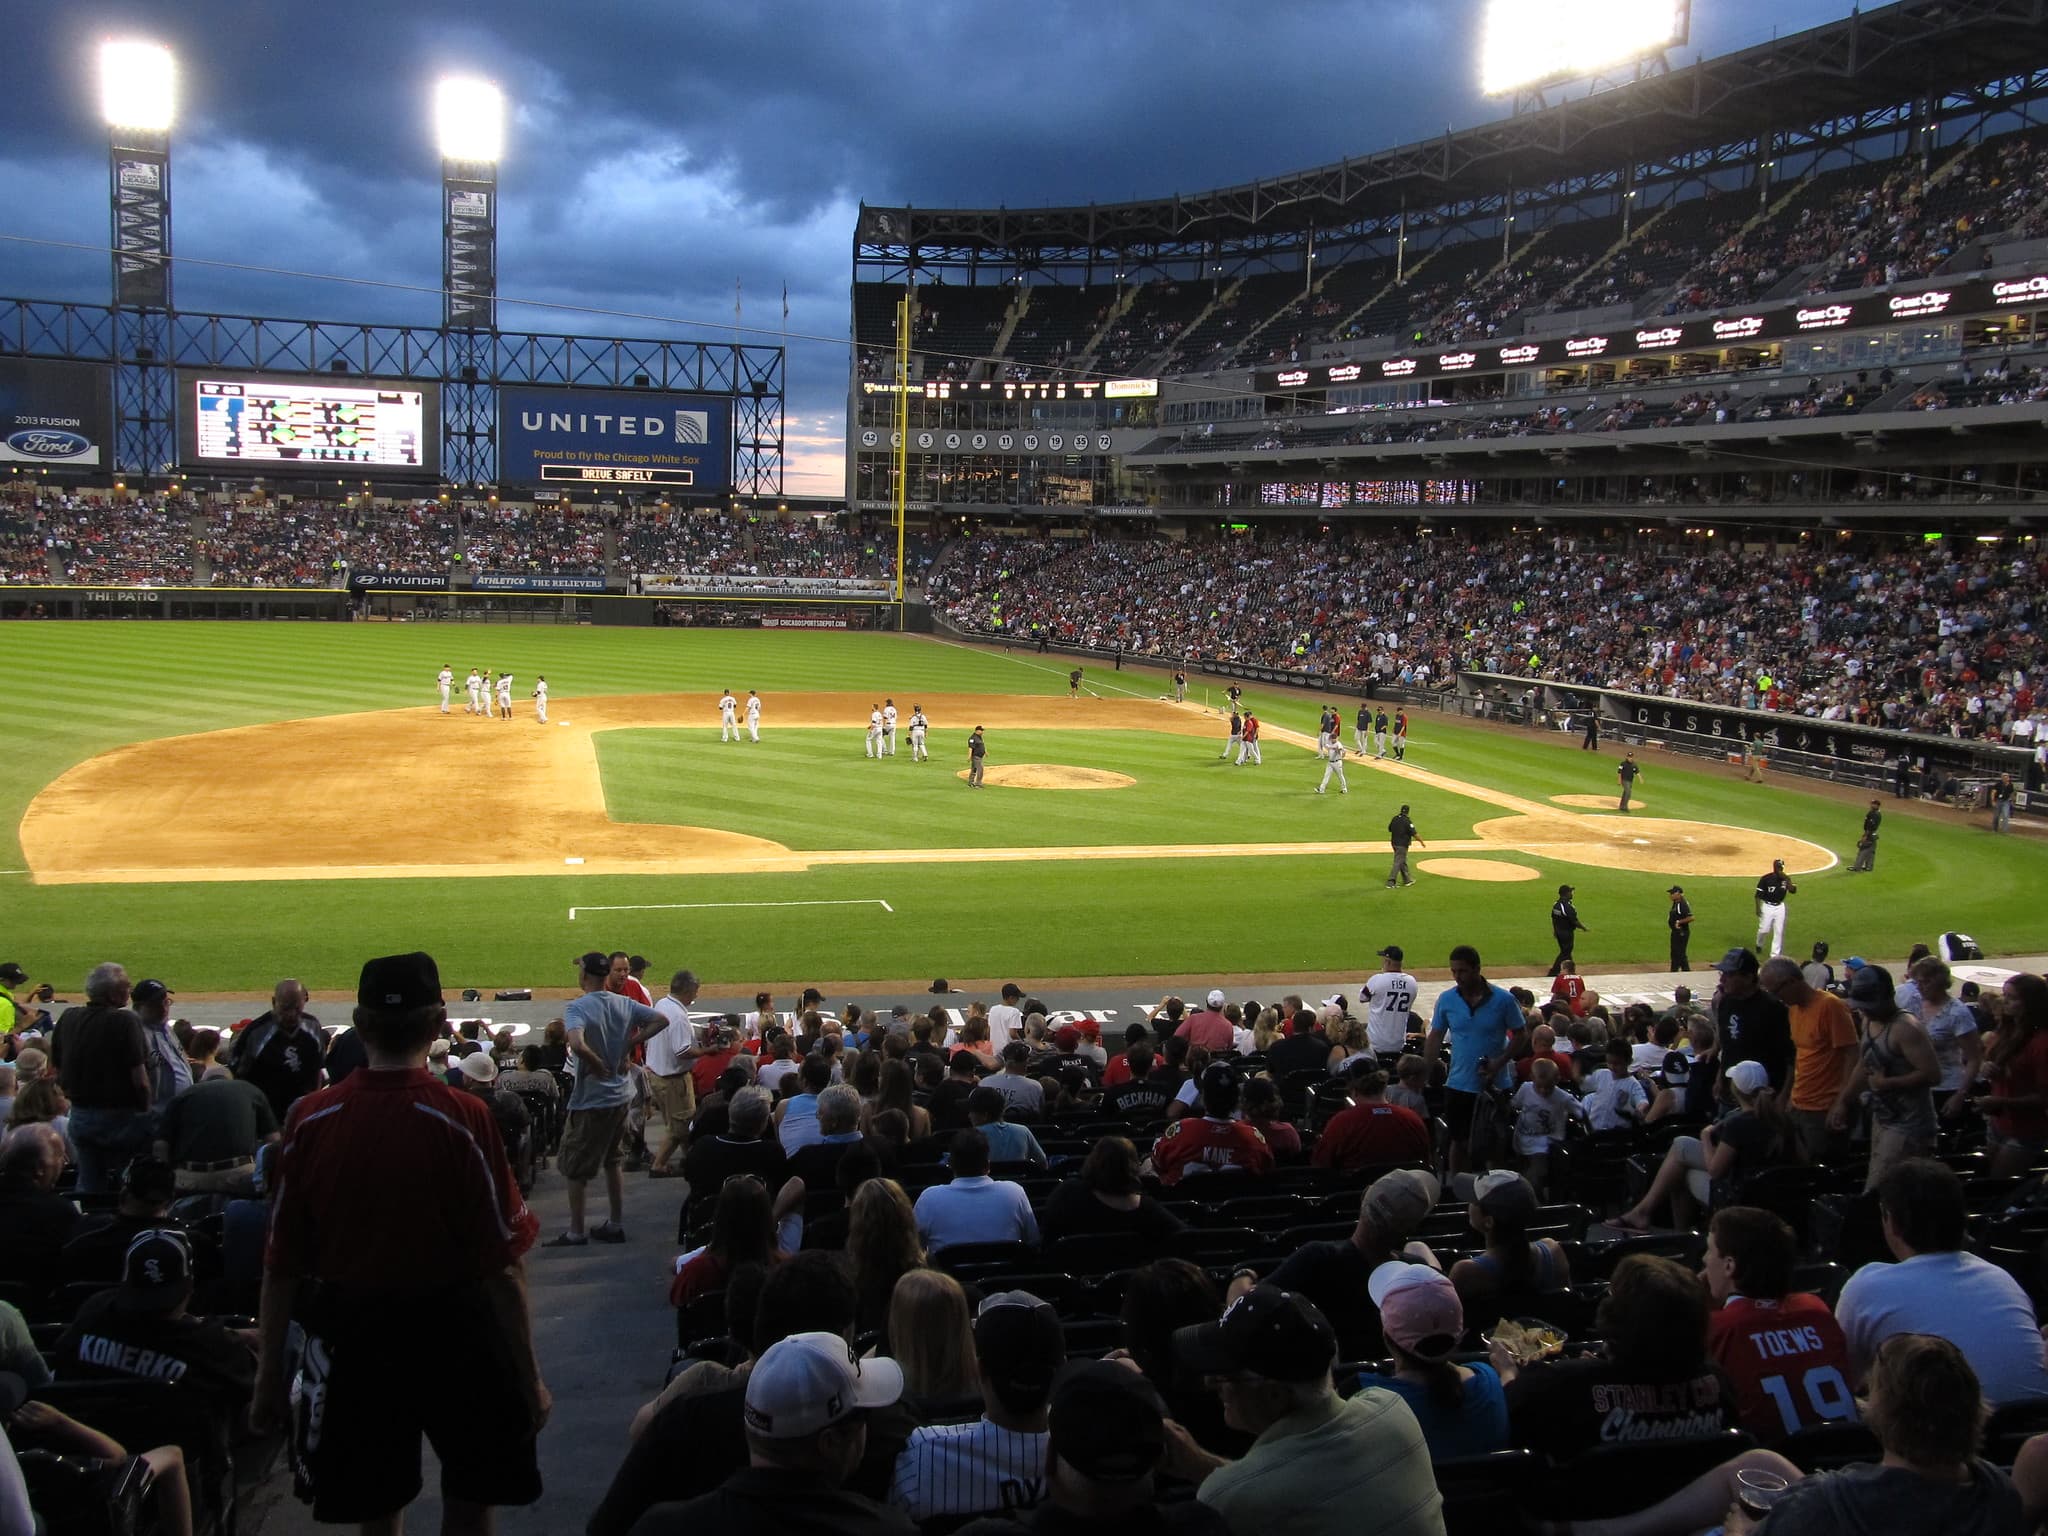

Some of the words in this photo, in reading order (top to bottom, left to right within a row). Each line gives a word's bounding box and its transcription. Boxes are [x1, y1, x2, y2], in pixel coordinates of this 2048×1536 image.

[1992, 282, 2028, 296] Great
[1889, 297, 1921, 310] Great
[1921, 292, 1951, 306] Clips
[1796, 309, 1825, 322] Great
[1825, 305, 1852, 320] Clips
[15, 415, 39, 425] 2013
[40, 417, 80, 427] FUSION
[522, 411, 665, 436] UNITED
[23, 433, 74, 454] Ford
[1027, 437, 1036, 445] 16
[1051, 437, 1060, 445] 19
[1075, 437, 1086, 445] 35
[1100, 437, 1109, 445] 72
[533, 449, 564, 460] Proud
[565, 451, 577, 461] to
[578, 451, 592, 463] fly
[594, 452, 610, 462] the
[612, 453, 650, 464] Chicago
[652, 455, 681, 465] White
[682, 456, 701, 465] Sox
[582, 469, 613, 480] DRIVE
[615, 470, 653, 481] SAFELY
[382, 576, 445, 586] HYUNDAI
[476, 575, 526, 585] ATHLETICO
[531, 579, 551, 587] THE
[552, 580, 602, 588] RELIEVERS
[117, 592, 159, 601] PATIO
[1391, 980, 1407, 989] FISK
[1386, 991, 1410, 1012] 72
[1203, 1145, 1235, 1164] KANE
[1750, 1325, 1824, 1360] TOEWS
[79, 1333, 188, 1381] KONERKO
[1592, 1383, 1688, 1413] STANLEY
[1760, 1364, 1858, 1439] 19
